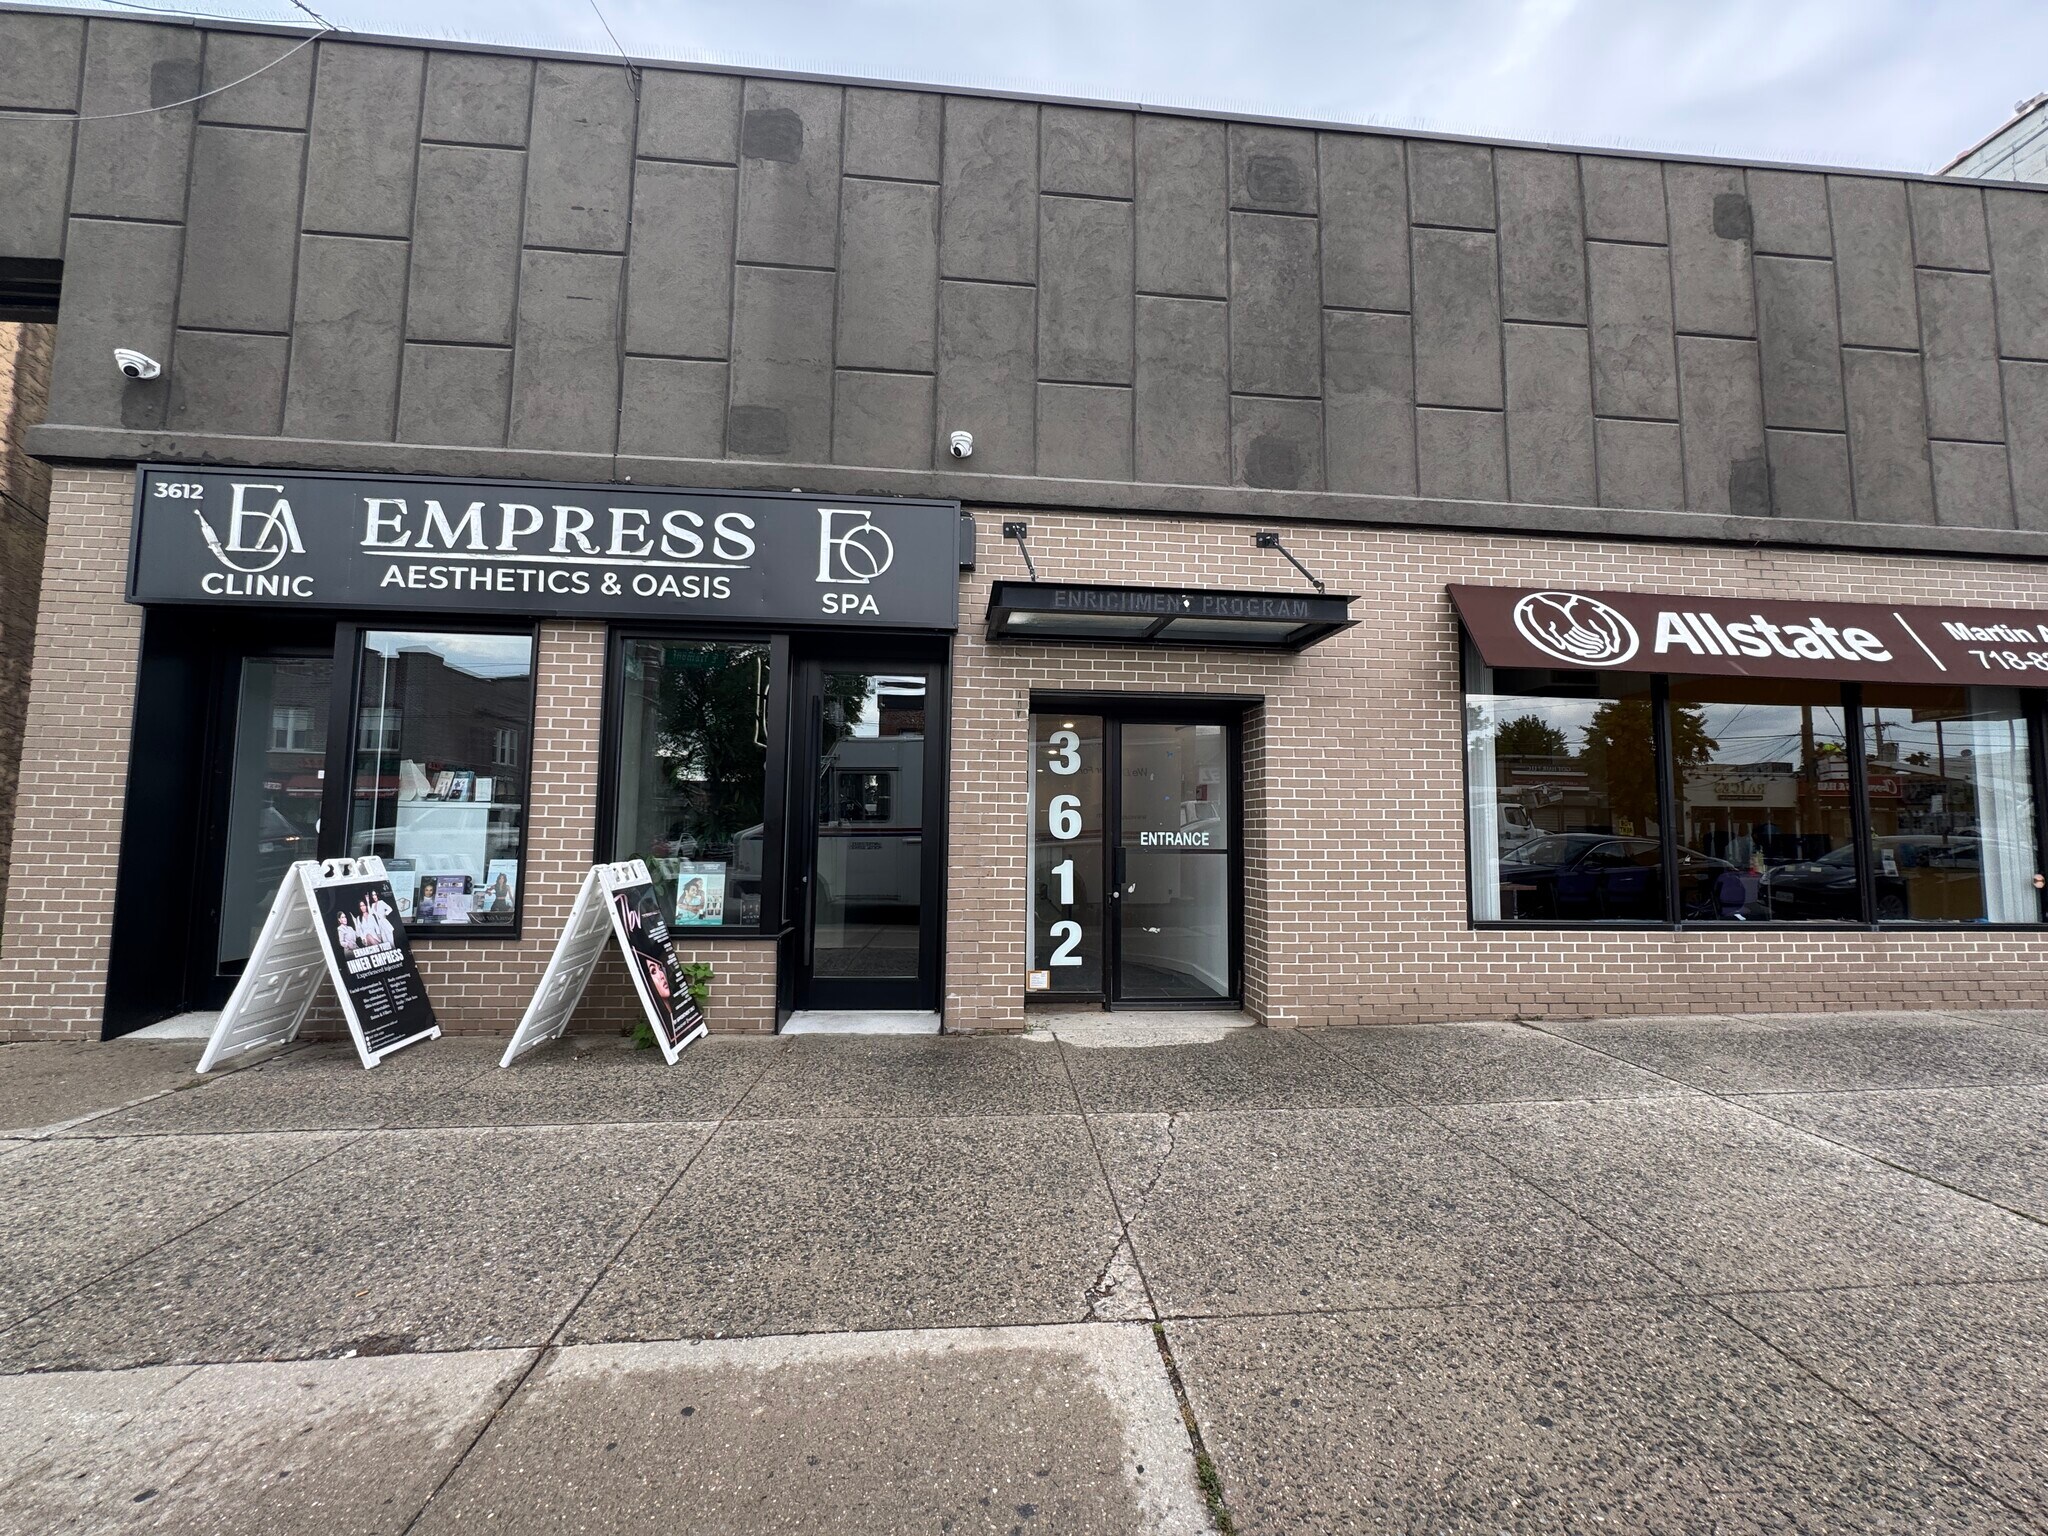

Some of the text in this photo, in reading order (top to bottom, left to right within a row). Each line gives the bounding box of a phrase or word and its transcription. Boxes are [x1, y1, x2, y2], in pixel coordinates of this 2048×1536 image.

[154, 482, 203, 499] 3612
[360, 497, 756, 560] EMPRESS
[201, 572, 313, 597] CLINIC
[380, 564, 731, 599] AESTHETICS & OASIS
[822, 593, 880, 615] SPA
[1202, 599, 1308, 617] PROGRAM
[1654, 611, 1893, 662] Allstate
[1941, 621, 2038, 643] Martin
[1140, 832, 1209, 846] ENTRANCE
[346, 948, 404, 973] INNER EMPRESS
